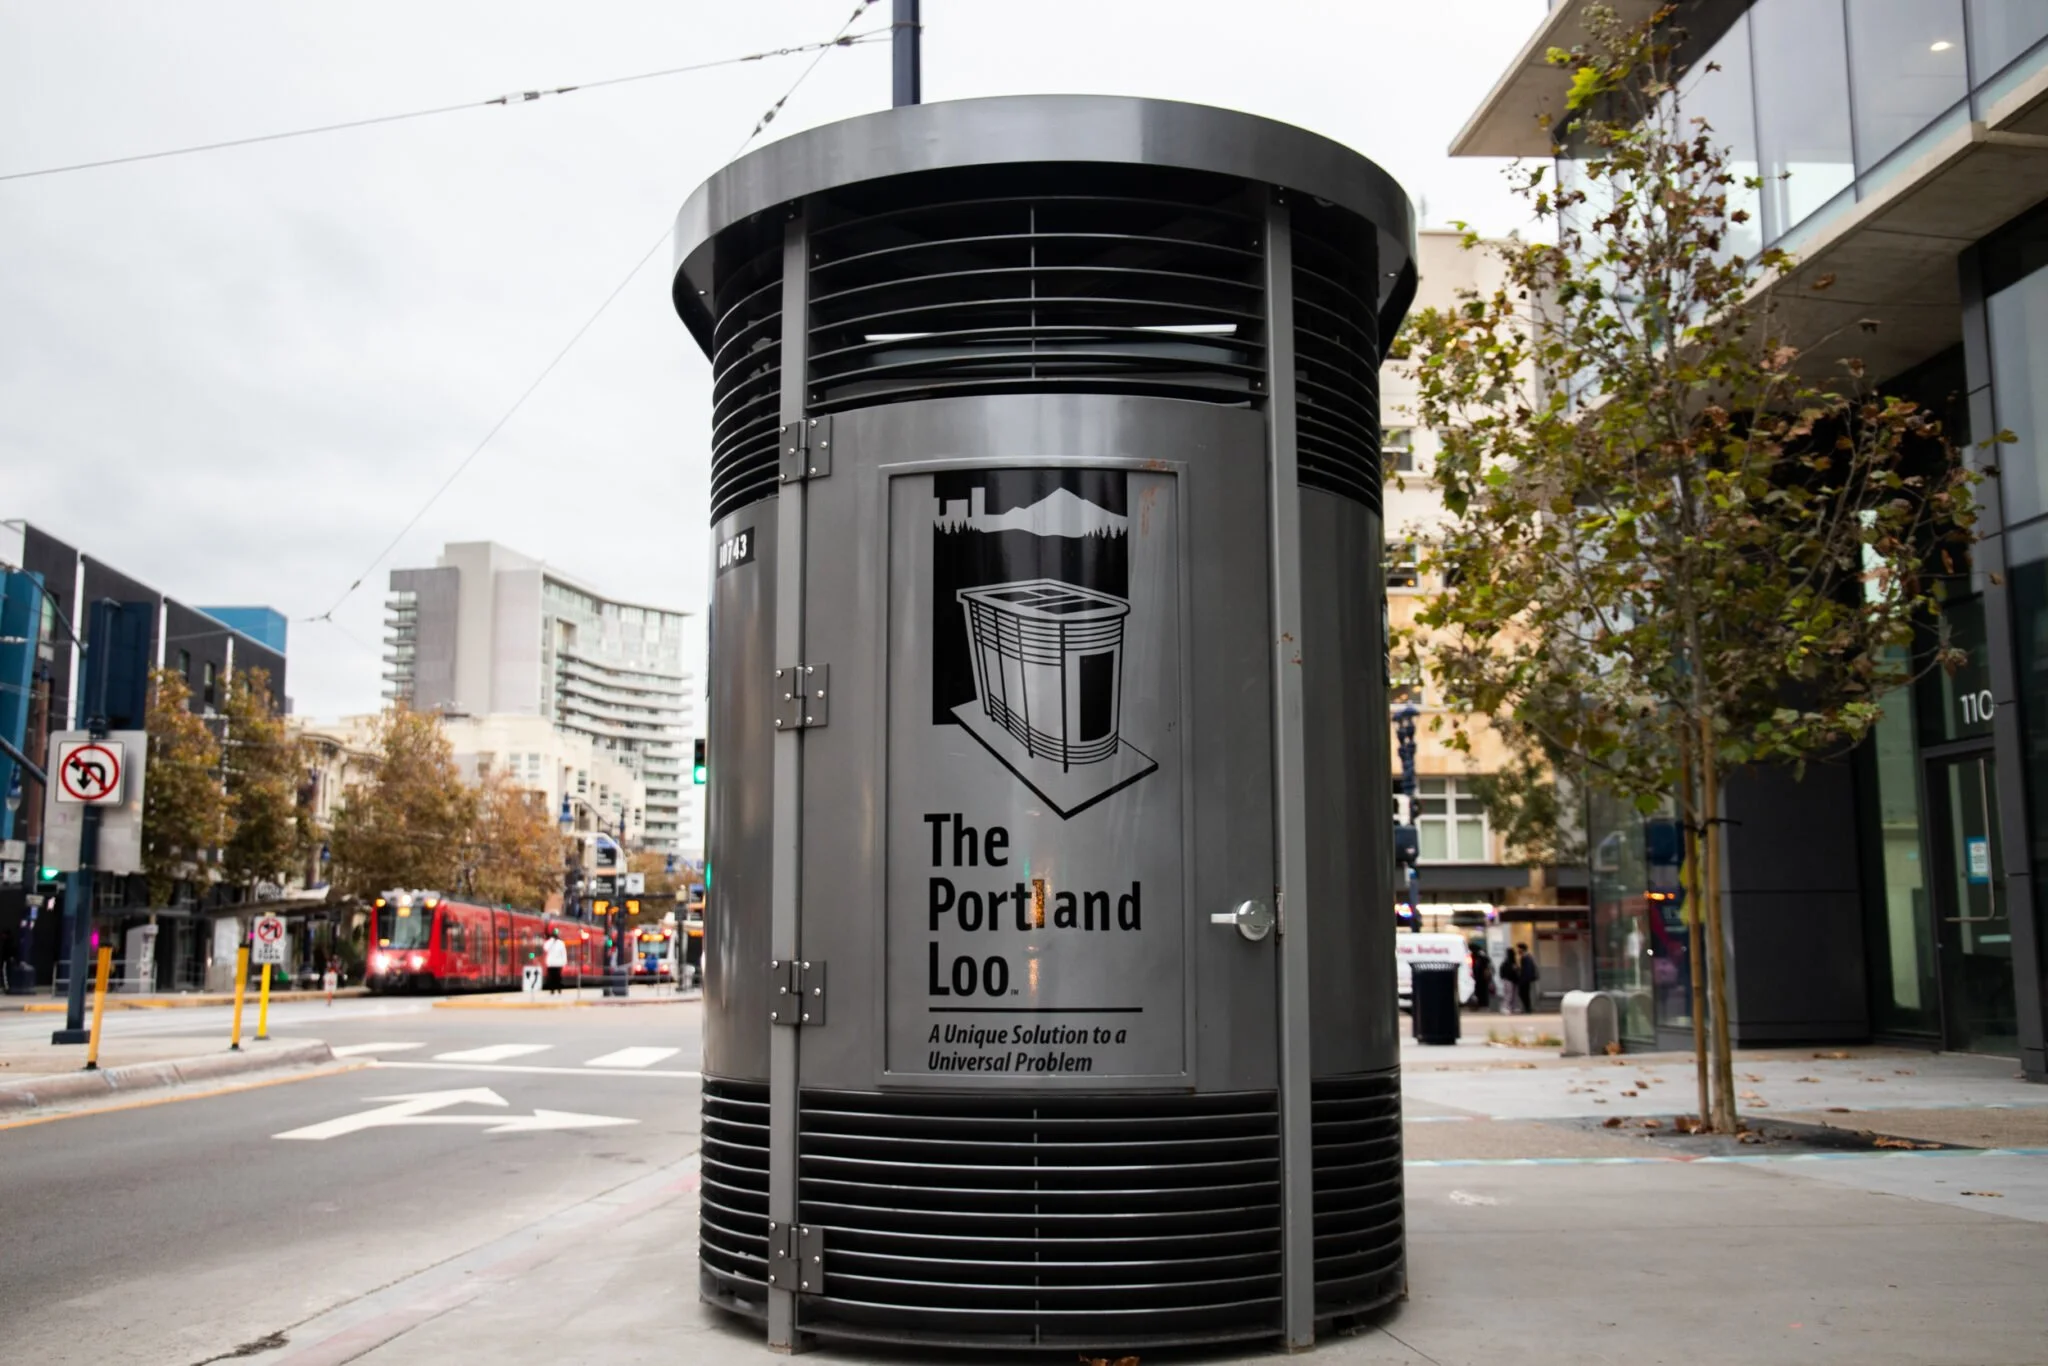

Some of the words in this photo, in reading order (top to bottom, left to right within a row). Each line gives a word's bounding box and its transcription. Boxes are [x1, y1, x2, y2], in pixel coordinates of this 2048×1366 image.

[1959, 689, 1995, 725] 110
[924, 813, 1009, 867] The
[928, 877, 1142, 932] Portland
[928, 941, 1009, 997] Loo
[928, 1024, 940, 1044] A
[944, 1024, 1008, 1049] Unique
[1011, 1024, 1088, 1044] Solution
[1093, 1026, 1111, 1044] to
[1115, 1029, 1127, 1044] a
[928, 1051, 1012, 1072] Universal
[1014, 1052, 1093, 1072] Problem
